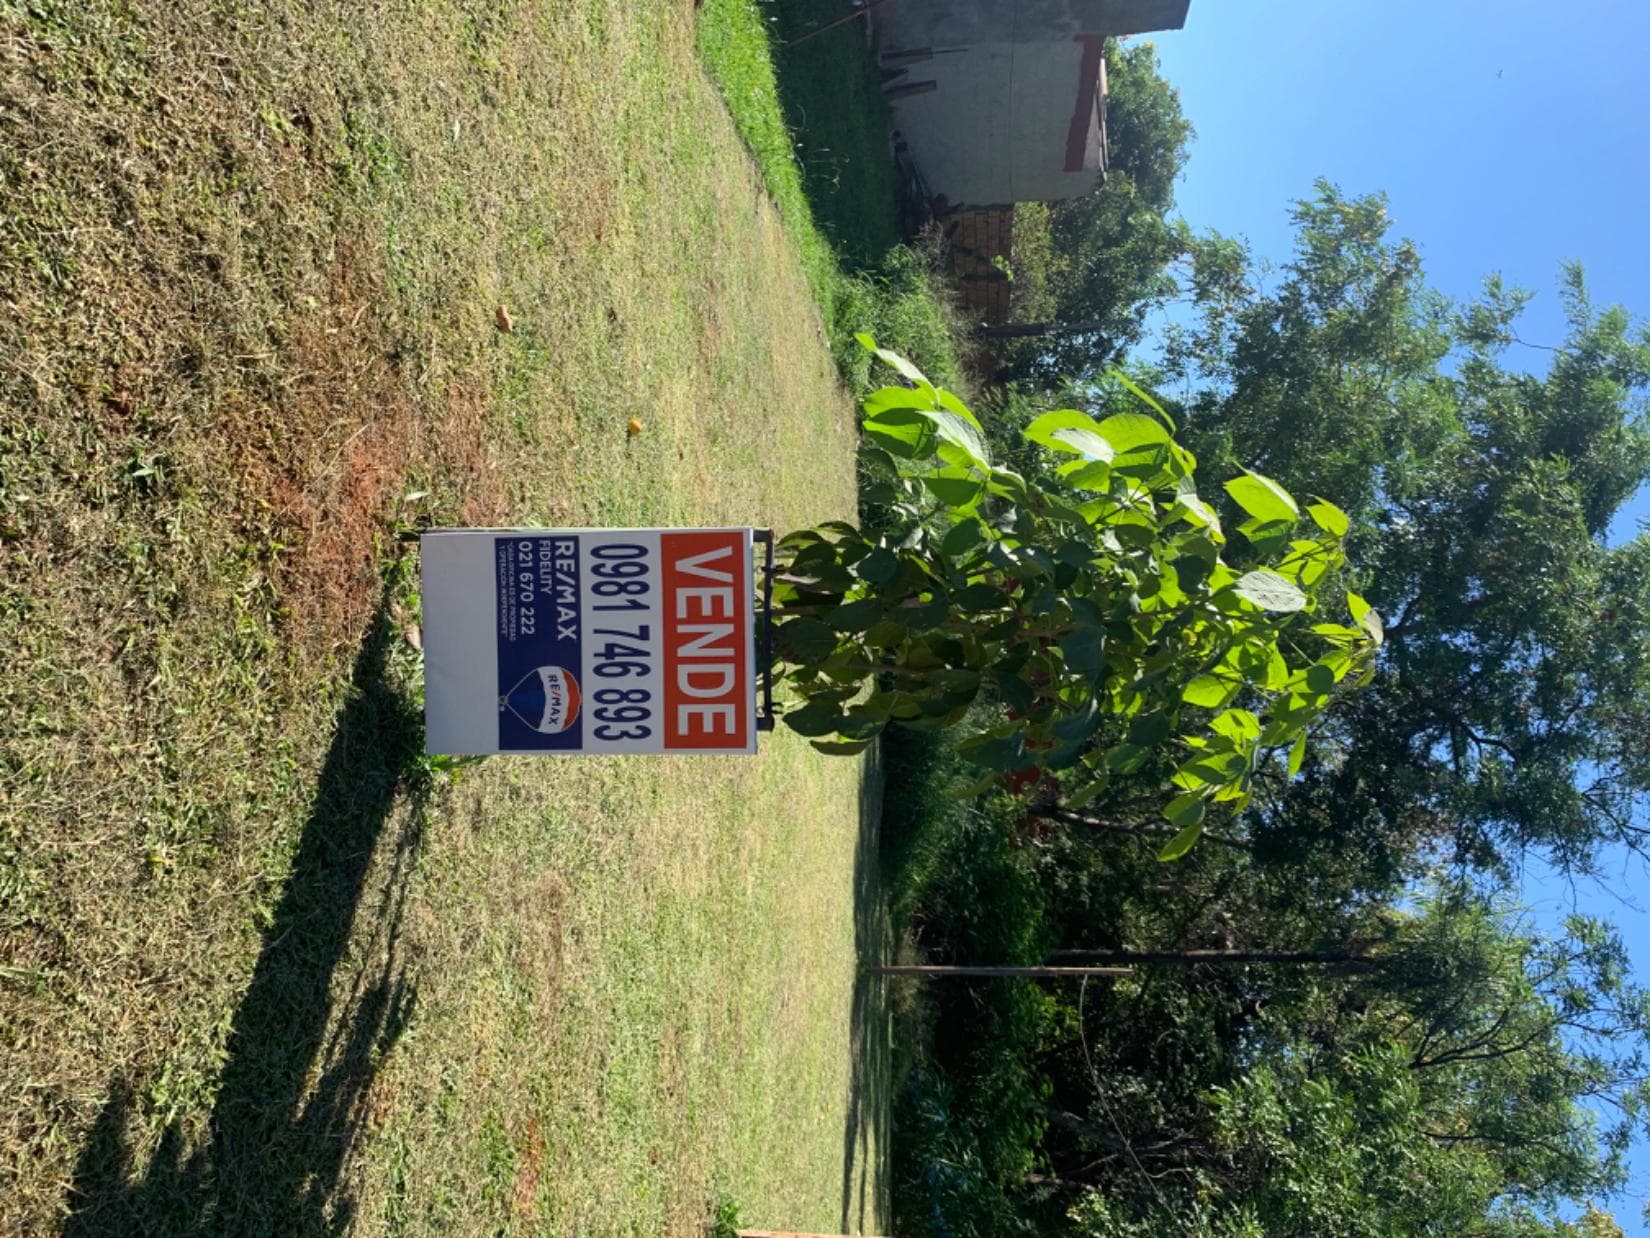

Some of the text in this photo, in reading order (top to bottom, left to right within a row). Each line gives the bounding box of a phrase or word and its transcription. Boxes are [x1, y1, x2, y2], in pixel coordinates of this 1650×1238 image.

[518, 541, 534, 635] 021 670 222
[539, 540, 552, 594] FIDELITY
[555, 541, 577, 641] RE/MAX
[591, 544, 652, 741] 0981 746 893
[675, 547, 736, 735] VENDE
[547, 675, 561, 726] RE/MAX
